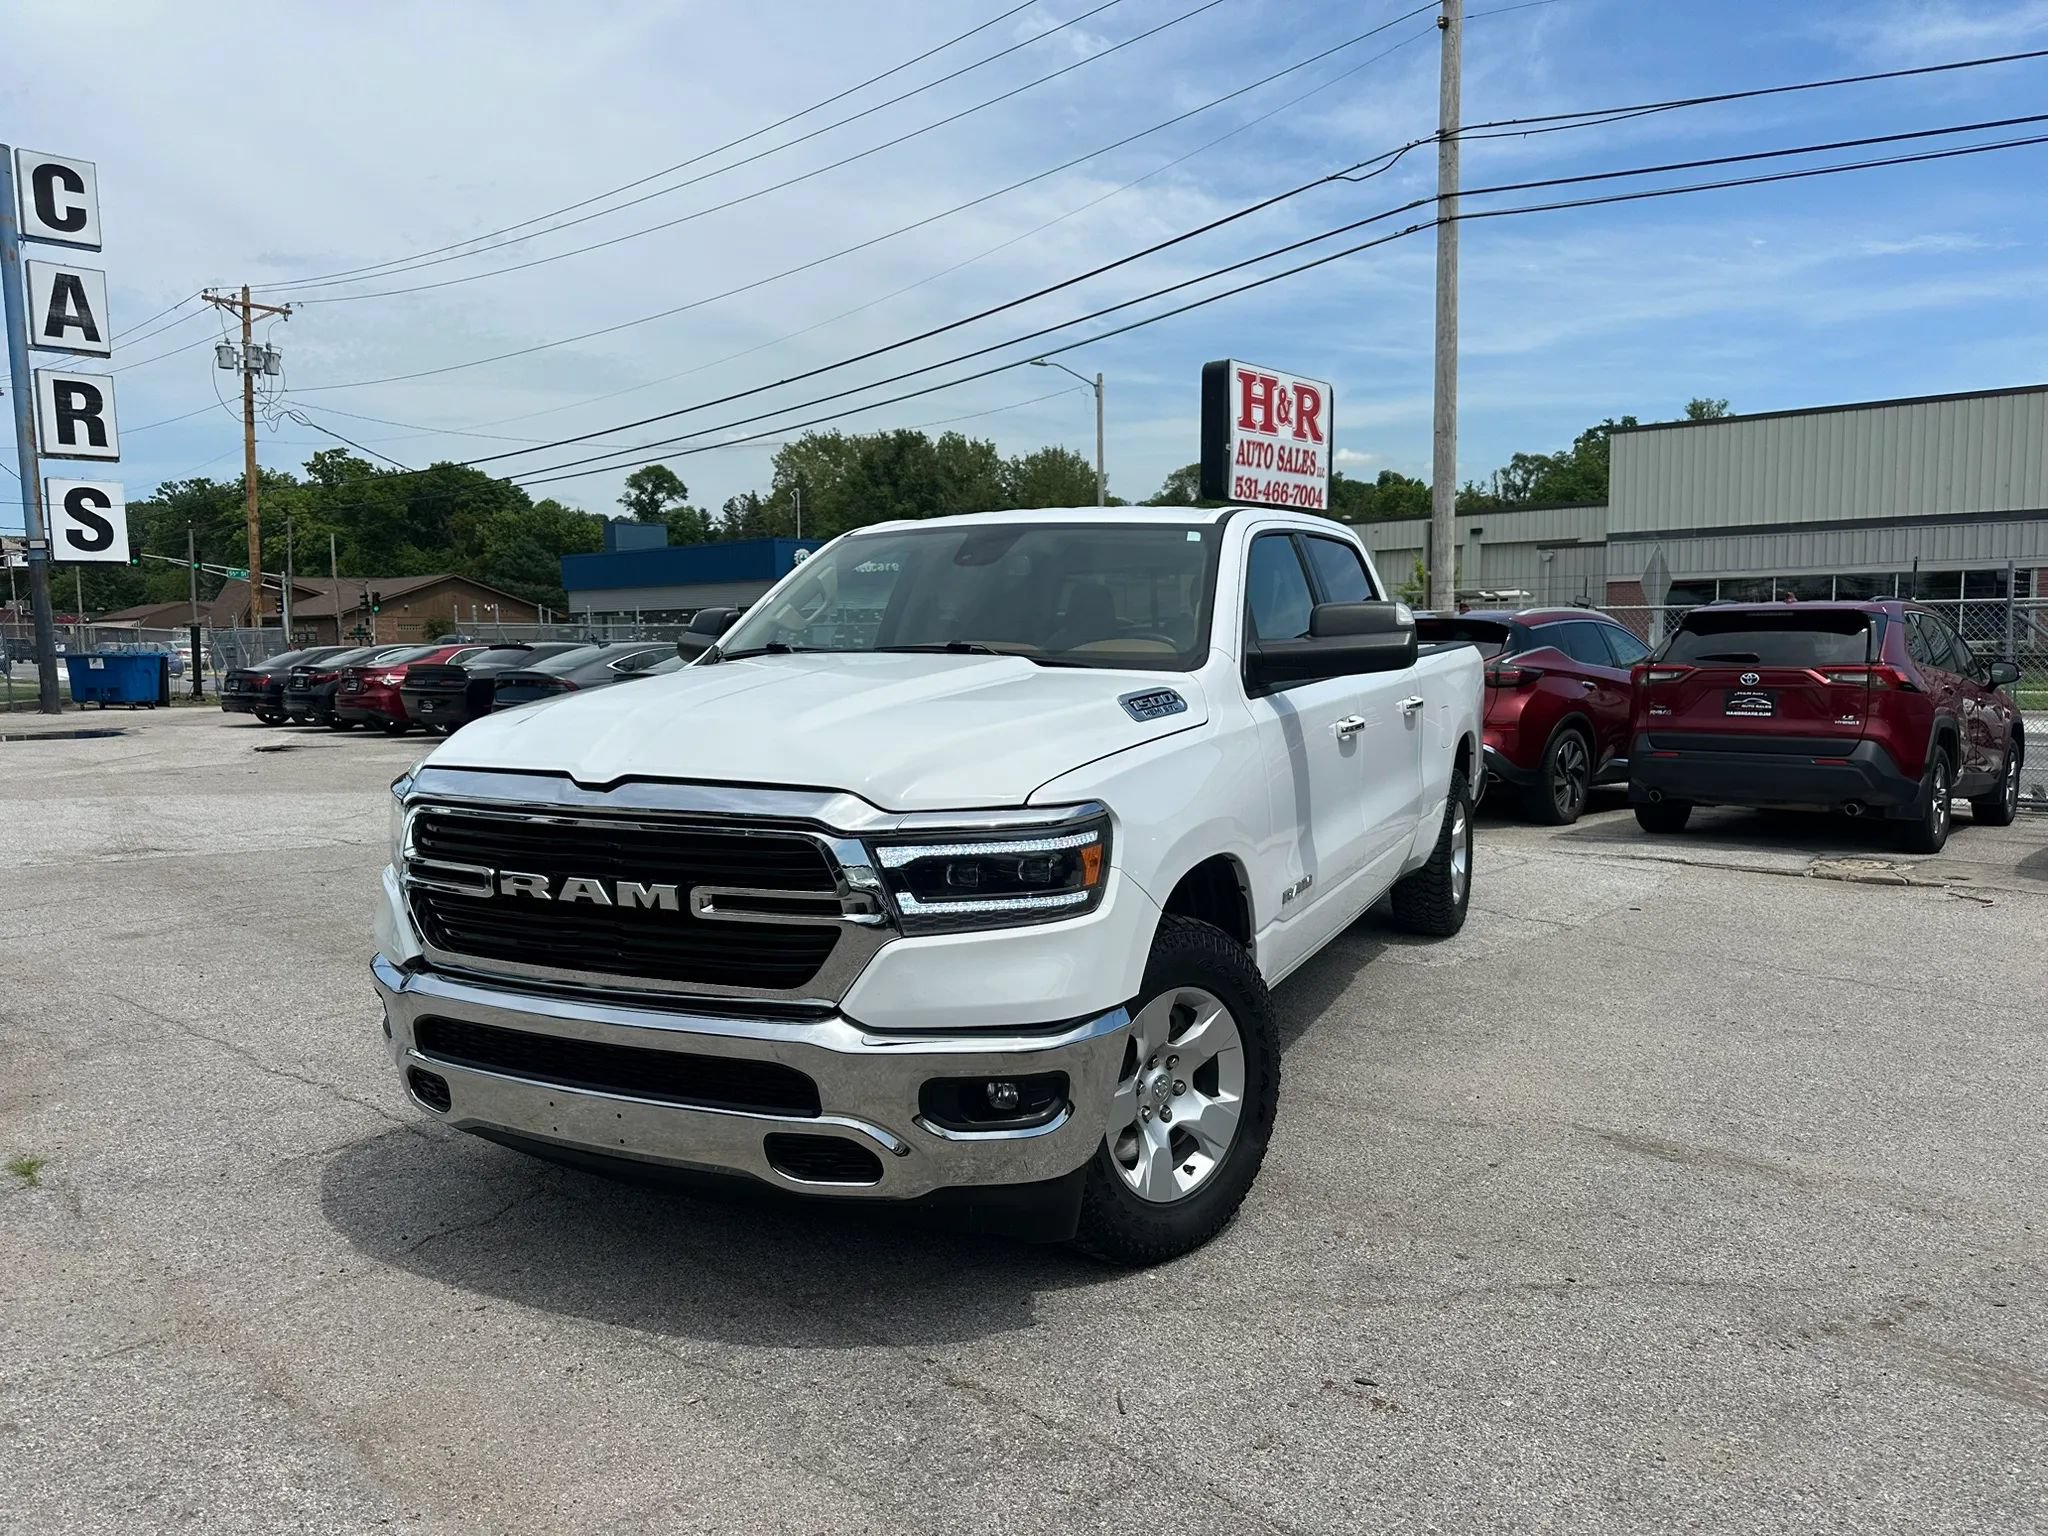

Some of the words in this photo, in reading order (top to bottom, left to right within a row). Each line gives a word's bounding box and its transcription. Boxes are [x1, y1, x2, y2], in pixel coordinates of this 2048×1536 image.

[32, 163, 115, 553] CARS
[1237, 368, 1324, 446] H&R
[1236, 438, 1274, 470] AUTO
[1277, 445, 1317, 477] SALES
[1235, 476, 1323, 508] 531-466-7004
[1129, 693, 1175, 711] 1500
[499, 869, 680, 912] RAM
